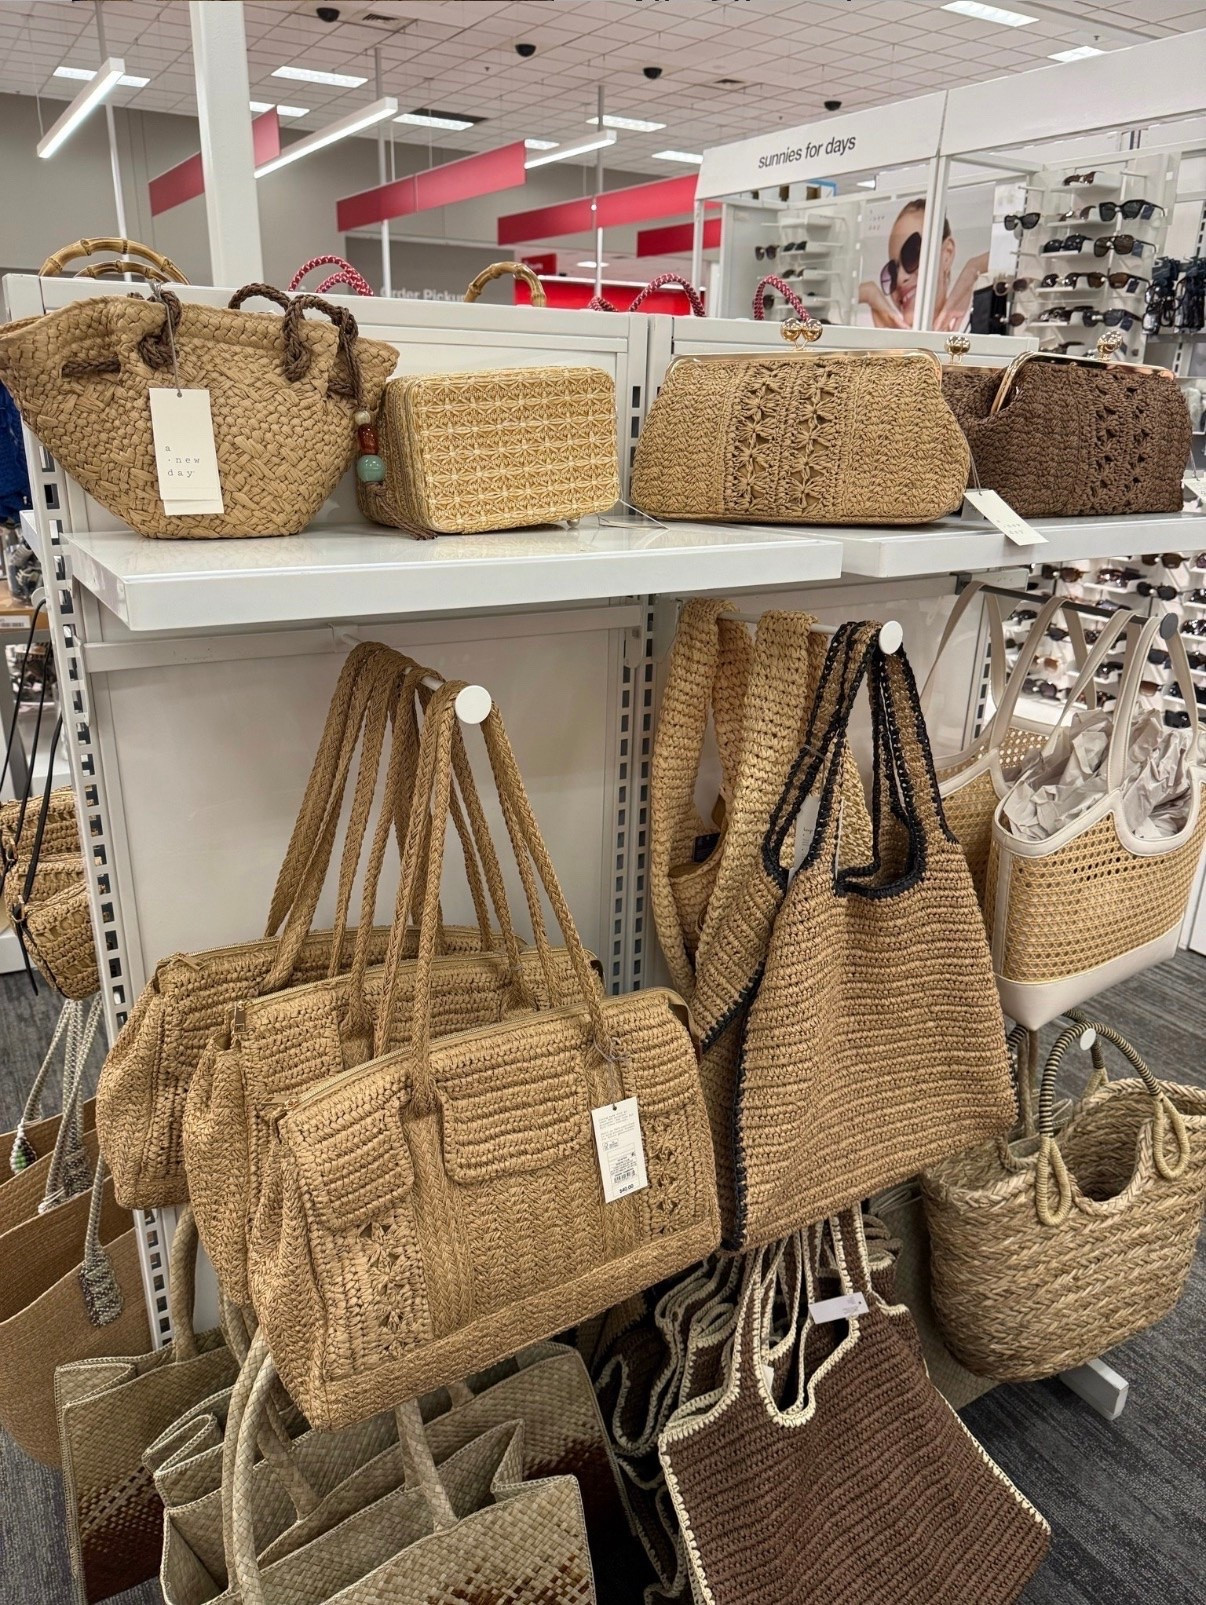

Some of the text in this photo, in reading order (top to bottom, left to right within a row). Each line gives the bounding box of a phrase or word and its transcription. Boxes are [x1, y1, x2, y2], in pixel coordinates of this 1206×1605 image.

[758, 136, 857, 169] sunnies for days
[167, 468, 194, 478] day
